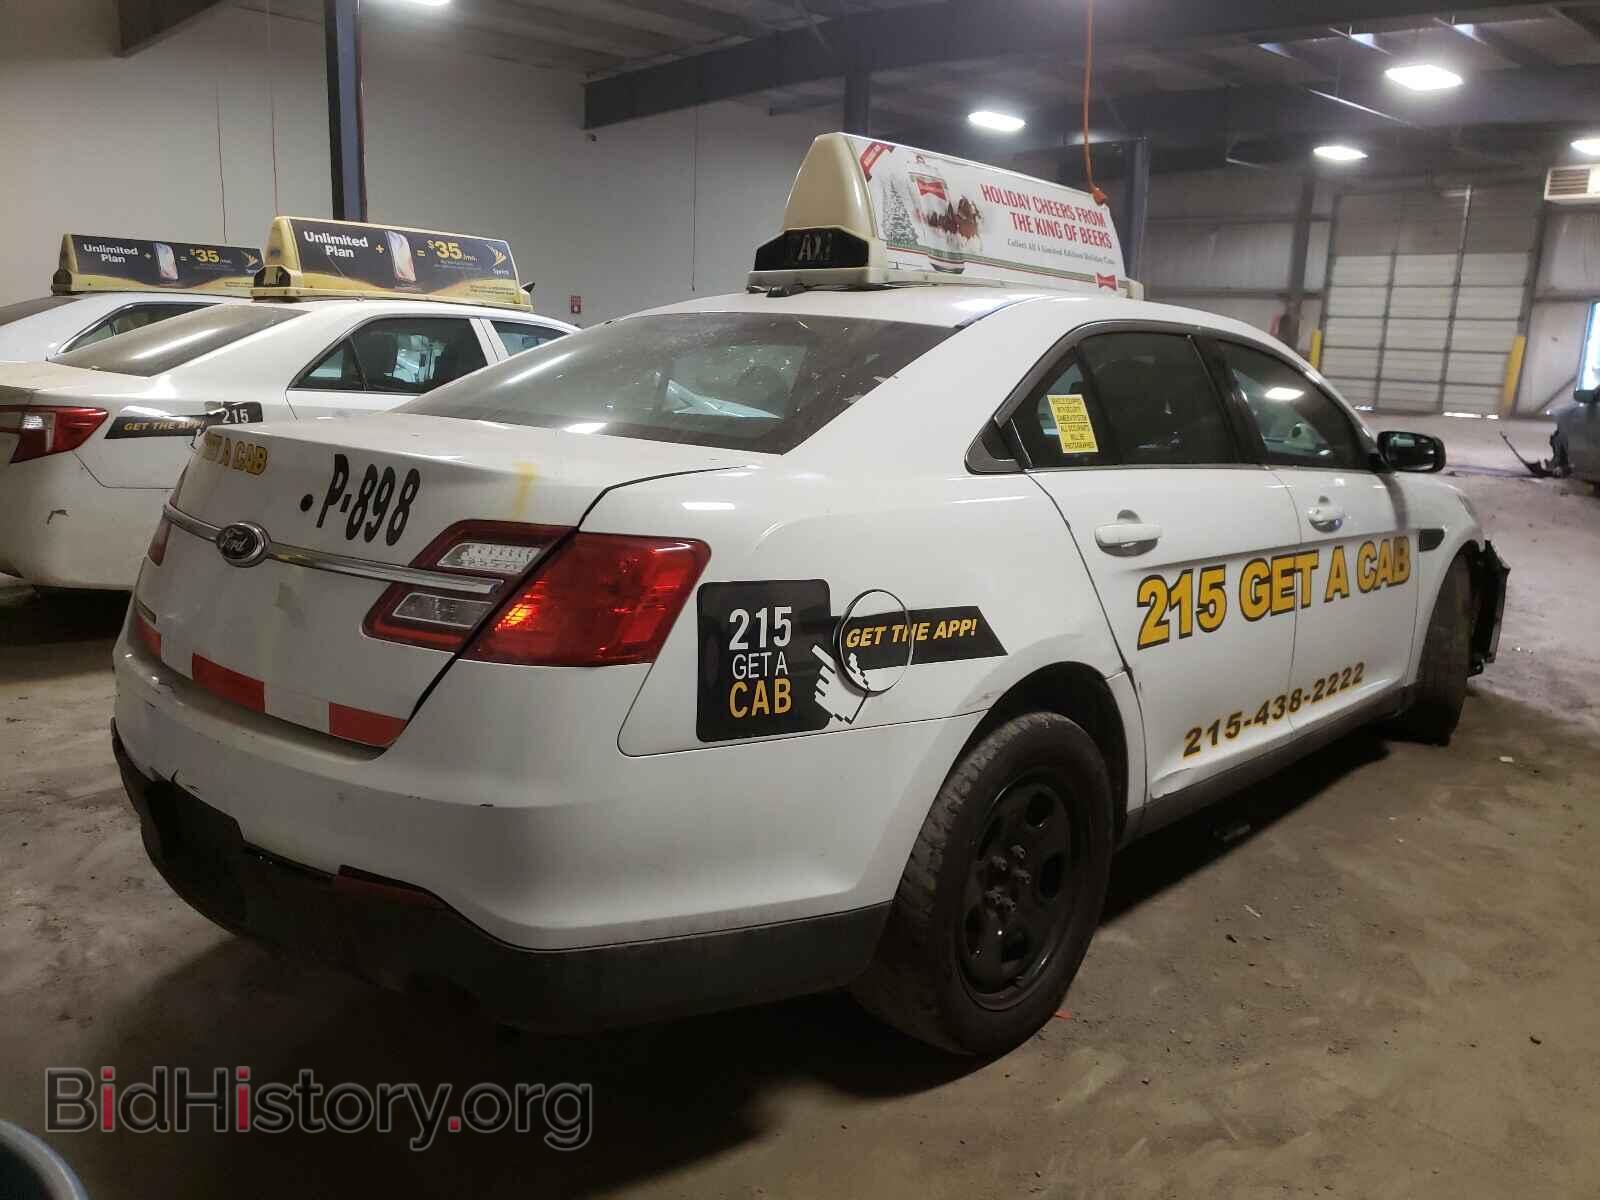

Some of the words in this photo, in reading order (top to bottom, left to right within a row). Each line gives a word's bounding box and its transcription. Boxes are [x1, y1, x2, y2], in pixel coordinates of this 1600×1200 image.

[980, 184, 1032, 211] HOLIDAY
[1033, 196, 1076, 221] CHEERS
[1075, 207, 1107, 228] FROM
[303, 231, 369, 248] Unlimited
[1009, 212, 1034, 233] THE
[1034, 217, 1063, 239] KING
[1064, 224, 1079, 242] OF
[1079, 227, 1113, 249] BEERS
[84, 243, 138, 256] Unlimited
[101, 253, 126, 264] Plan
[325, 244, 355, 258] Plan
[124, 422, 148, 432] GET
[152, 421, 175, 431] THE
[222, 408, 249, 424] 215
[232, 441, 268, 476] CAB
[316, 454, 420, 546] P-898
[1137, 564, 1228, 650] 215
[1239, 549, 1320, 622] GET
[1324, 545, 1350, 603] A
[1356, 536, 1412, 593] CAB
[729, 605, 793, 650] 215
[846, 625, 882, 648] GET
[891, 622, 928, 645] THE
[933, 618, 978, 640] APP!
[732, 652, 771, 680] GET
[775, 650, 789, 676] A
[729, 677, 793, 718] CAB
[1182, 662, 1366, 758] 215-438-2222
